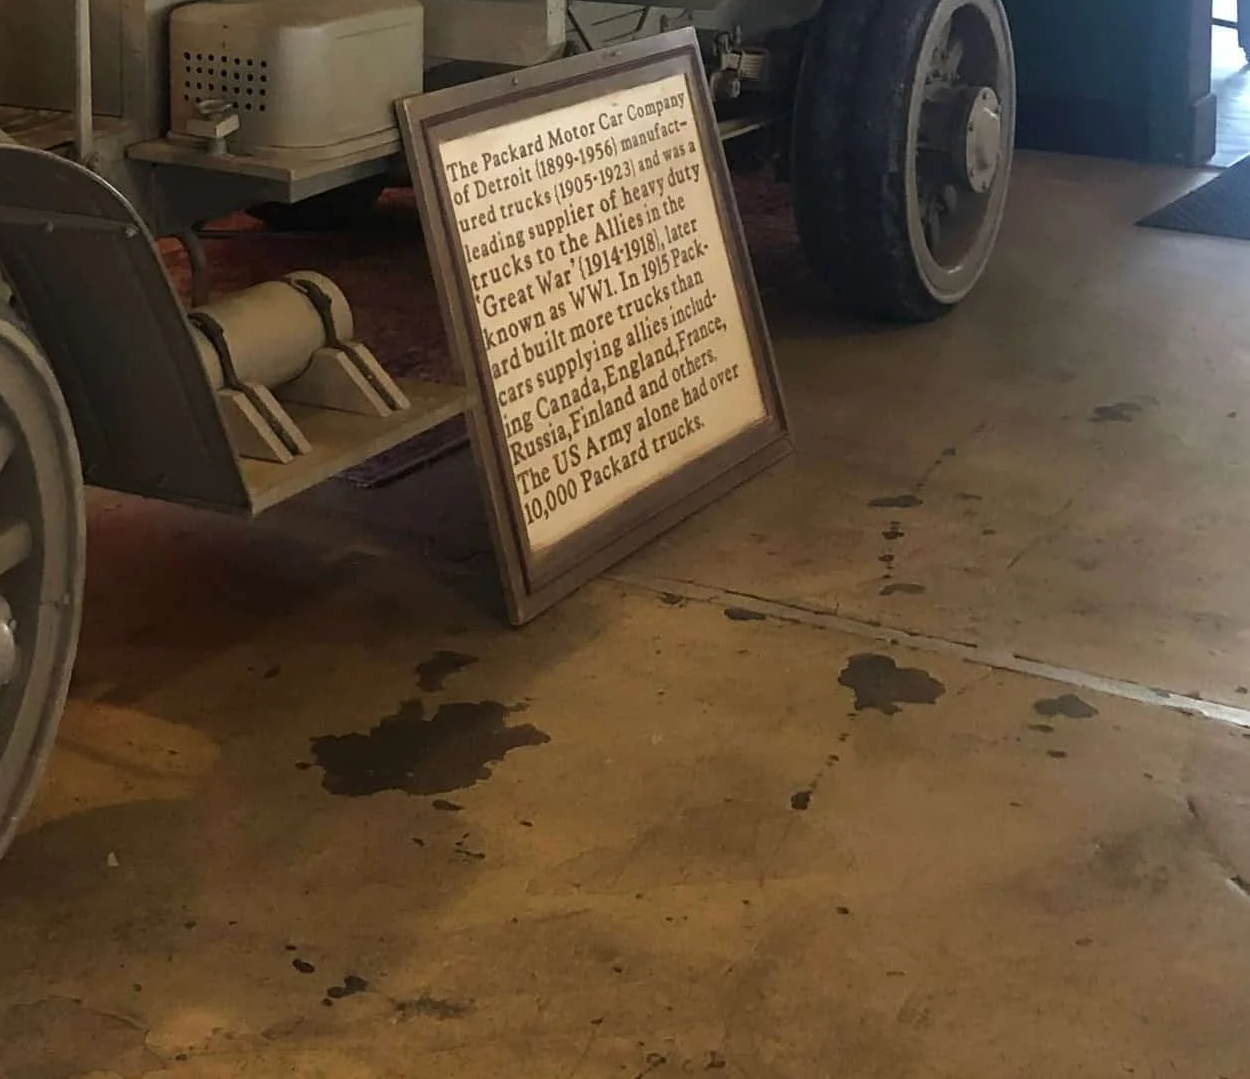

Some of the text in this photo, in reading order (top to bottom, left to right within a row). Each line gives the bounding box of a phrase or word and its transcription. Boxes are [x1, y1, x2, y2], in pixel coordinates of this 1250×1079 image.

[446, 92, 685, 182] The Packard Motor Car Company
[453, 120, 687, 206] of Detroit (1899-1956) manufact-
[459, 205, 497, 232] ured
[500, 190, 551, 219] trucks
[638, 150, 660, 172] and
[662, 144, 685, 162] was
[688, 141, 696, 154] a
[464, 164, 699, 263] leading supplier of heavy duty
[665, 218, 698, 244] later
[470, 195, 685, 291] trucks to the Allies in the
[483, 239, 708, 351] known as WW1. In 1915 Pack-
[492, 271, 704, 379] ard built more trucks than
[498, 288, 716, 407] cars supplying allies includ-
[639, 368, 669, 399] and
[672, 349, 717, 382] others.
[504, 411, 534, 438] ing
[517, 363, 739, 495] The US Army alone had over
[524, 415, 705, 525] 10,000 Packard trucks.
